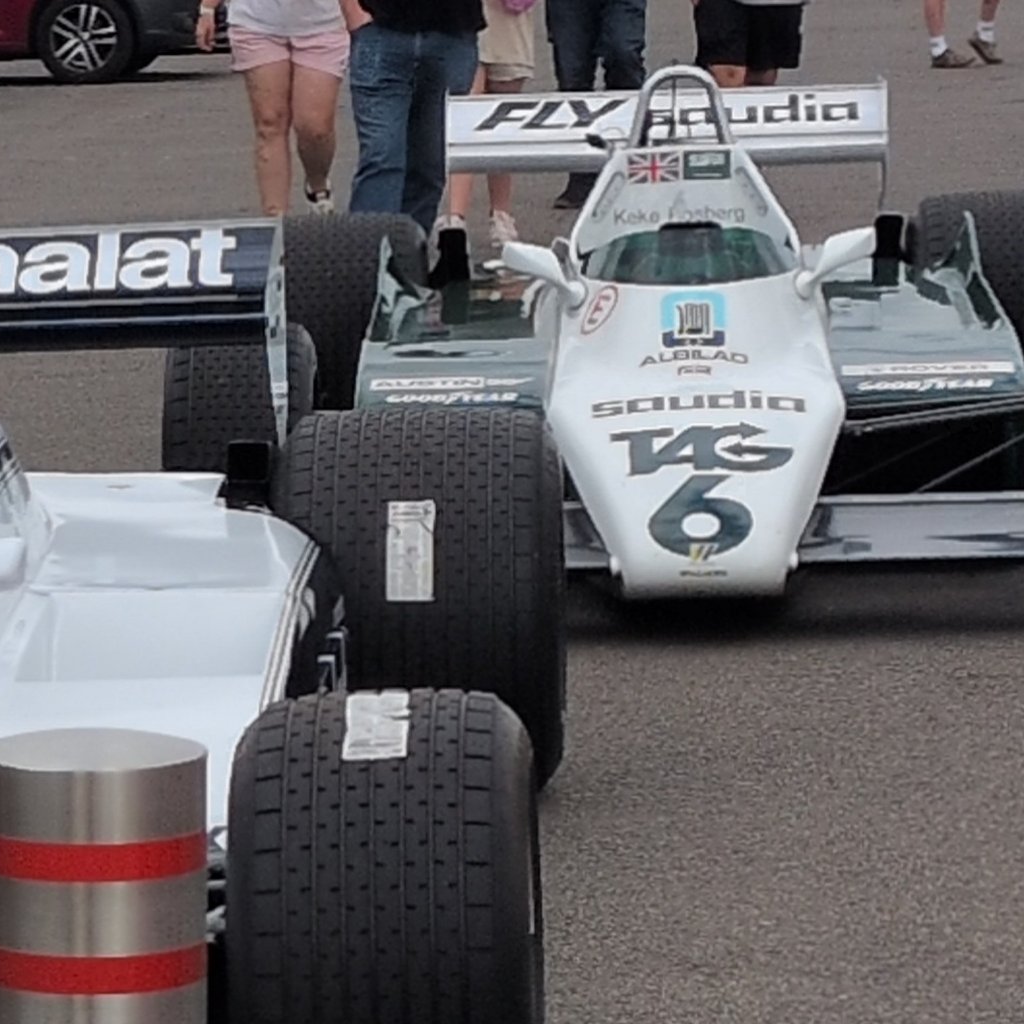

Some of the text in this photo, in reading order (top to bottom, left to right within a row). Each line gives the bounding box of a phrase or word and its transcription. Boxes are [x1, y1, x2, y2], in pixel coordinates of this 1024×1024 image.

[474, 99, 630, 131] FLY
[592, 390, 807, 418] saudia
[609, 421, 795, 476] TAG
[648, 474, 753, 558] 6
